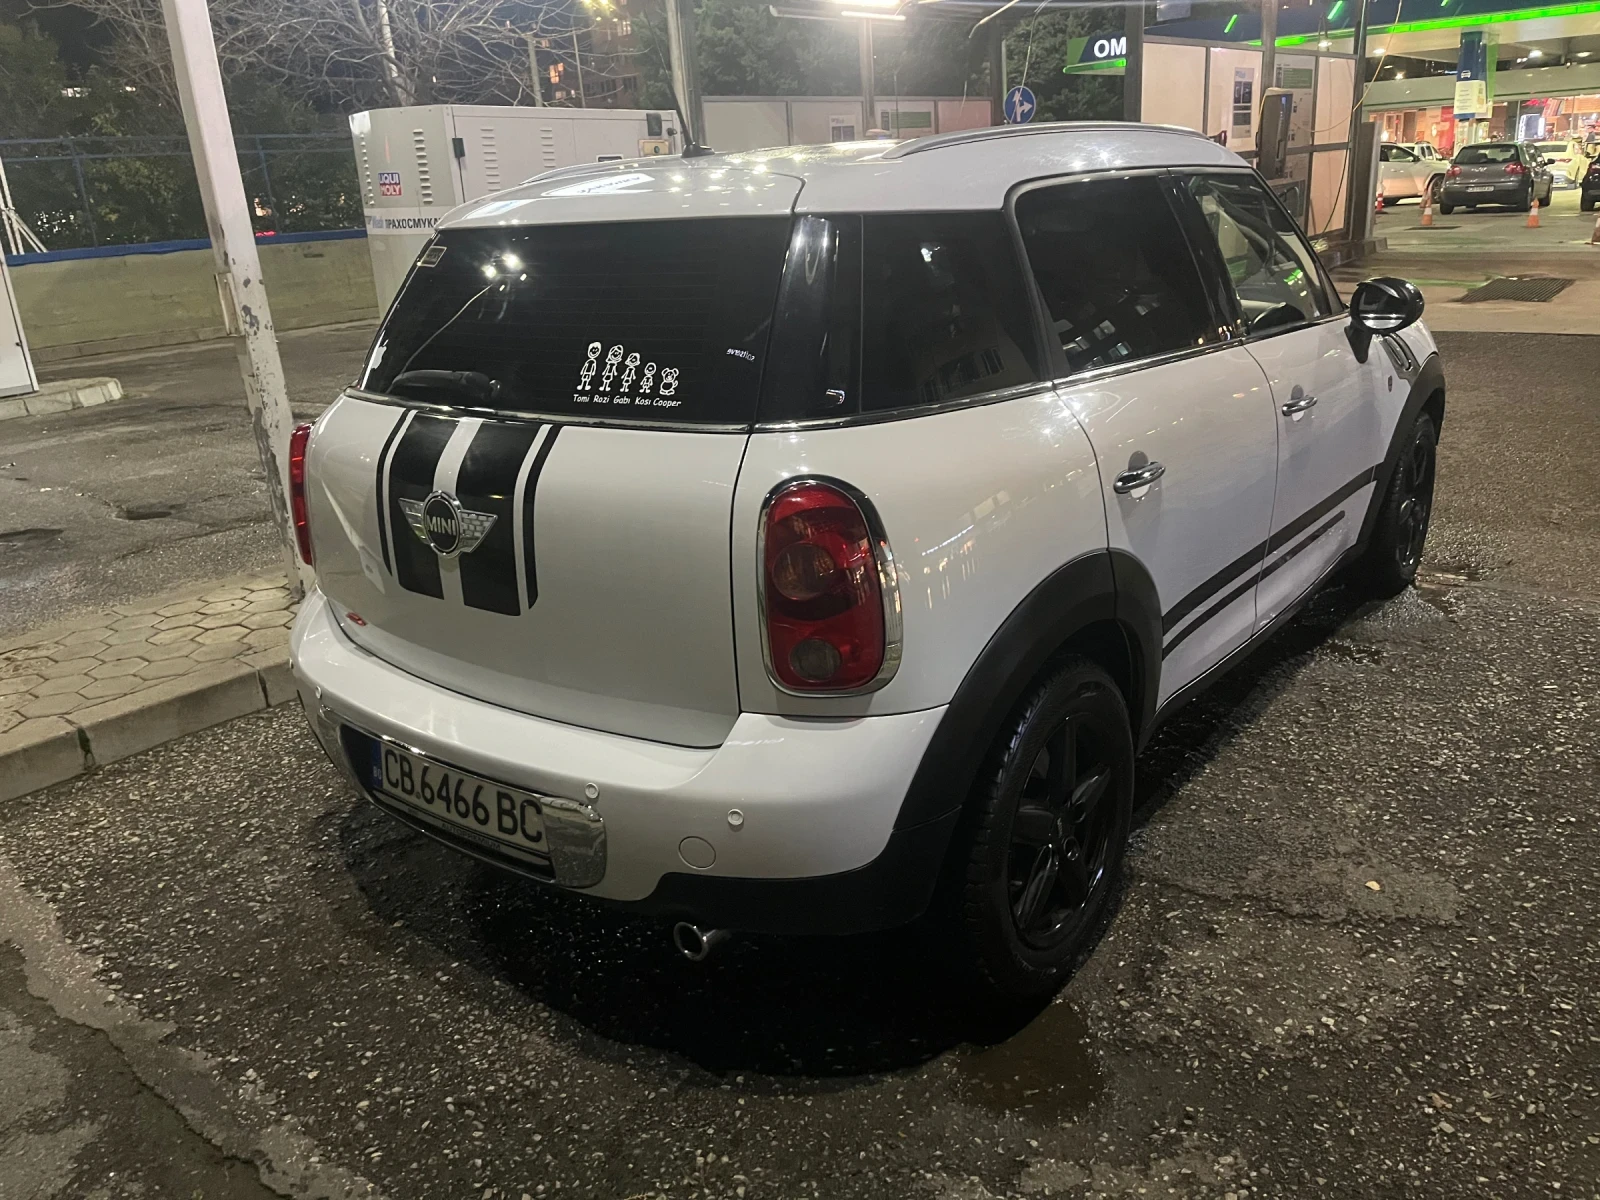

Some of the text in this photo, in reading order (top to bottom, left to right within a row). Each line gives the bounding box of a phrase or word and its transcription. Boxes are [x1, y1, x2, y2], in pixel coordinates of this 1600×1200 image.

[1094, 36, 1127, 58] OM
[573, 394, 591, 403] Tomi
[653, 397, 682, 408] Cooper
[426, 514, 457, 536] MINI
